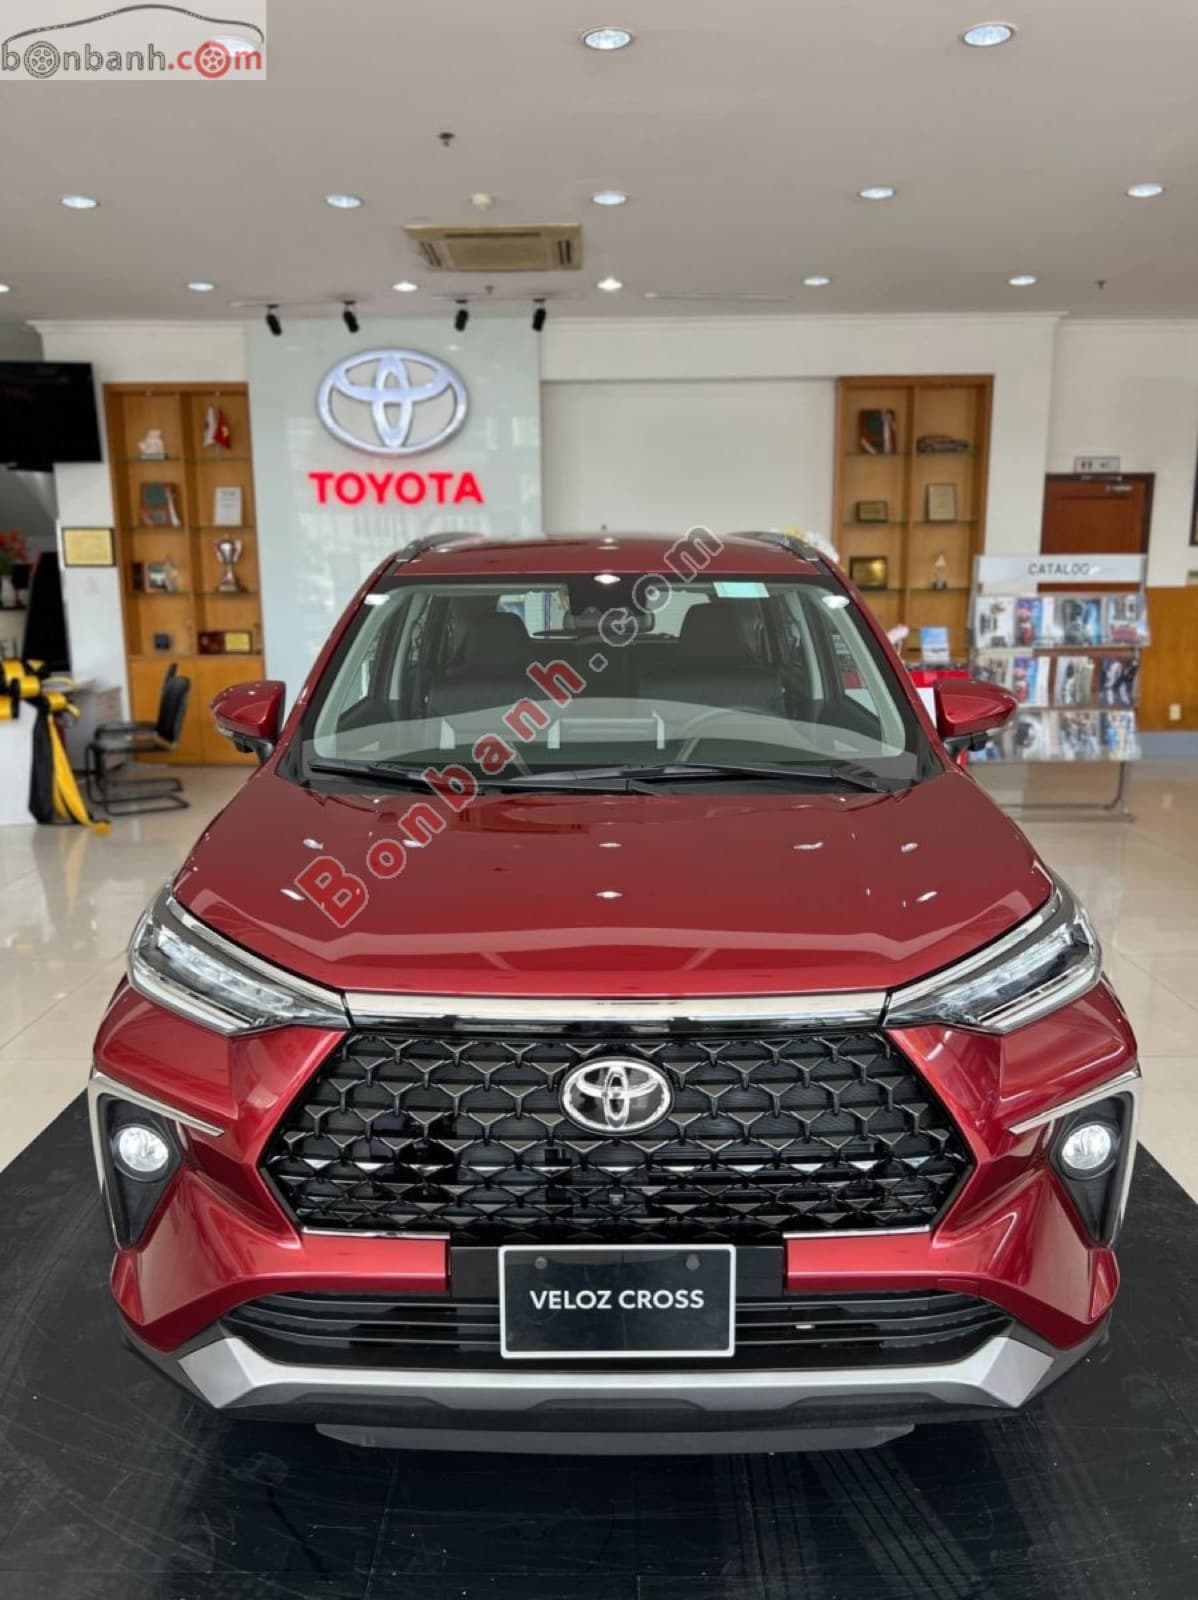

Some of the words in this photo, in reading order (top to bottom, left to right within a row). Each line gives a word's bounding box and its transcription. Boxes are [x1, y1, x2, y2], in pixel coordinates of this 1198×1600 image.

[308, 471, 484, 505] TOYOTA
[529, 1289, 613, 1310] VELOZ
[617, 1288, 705, 1310] CROSS
